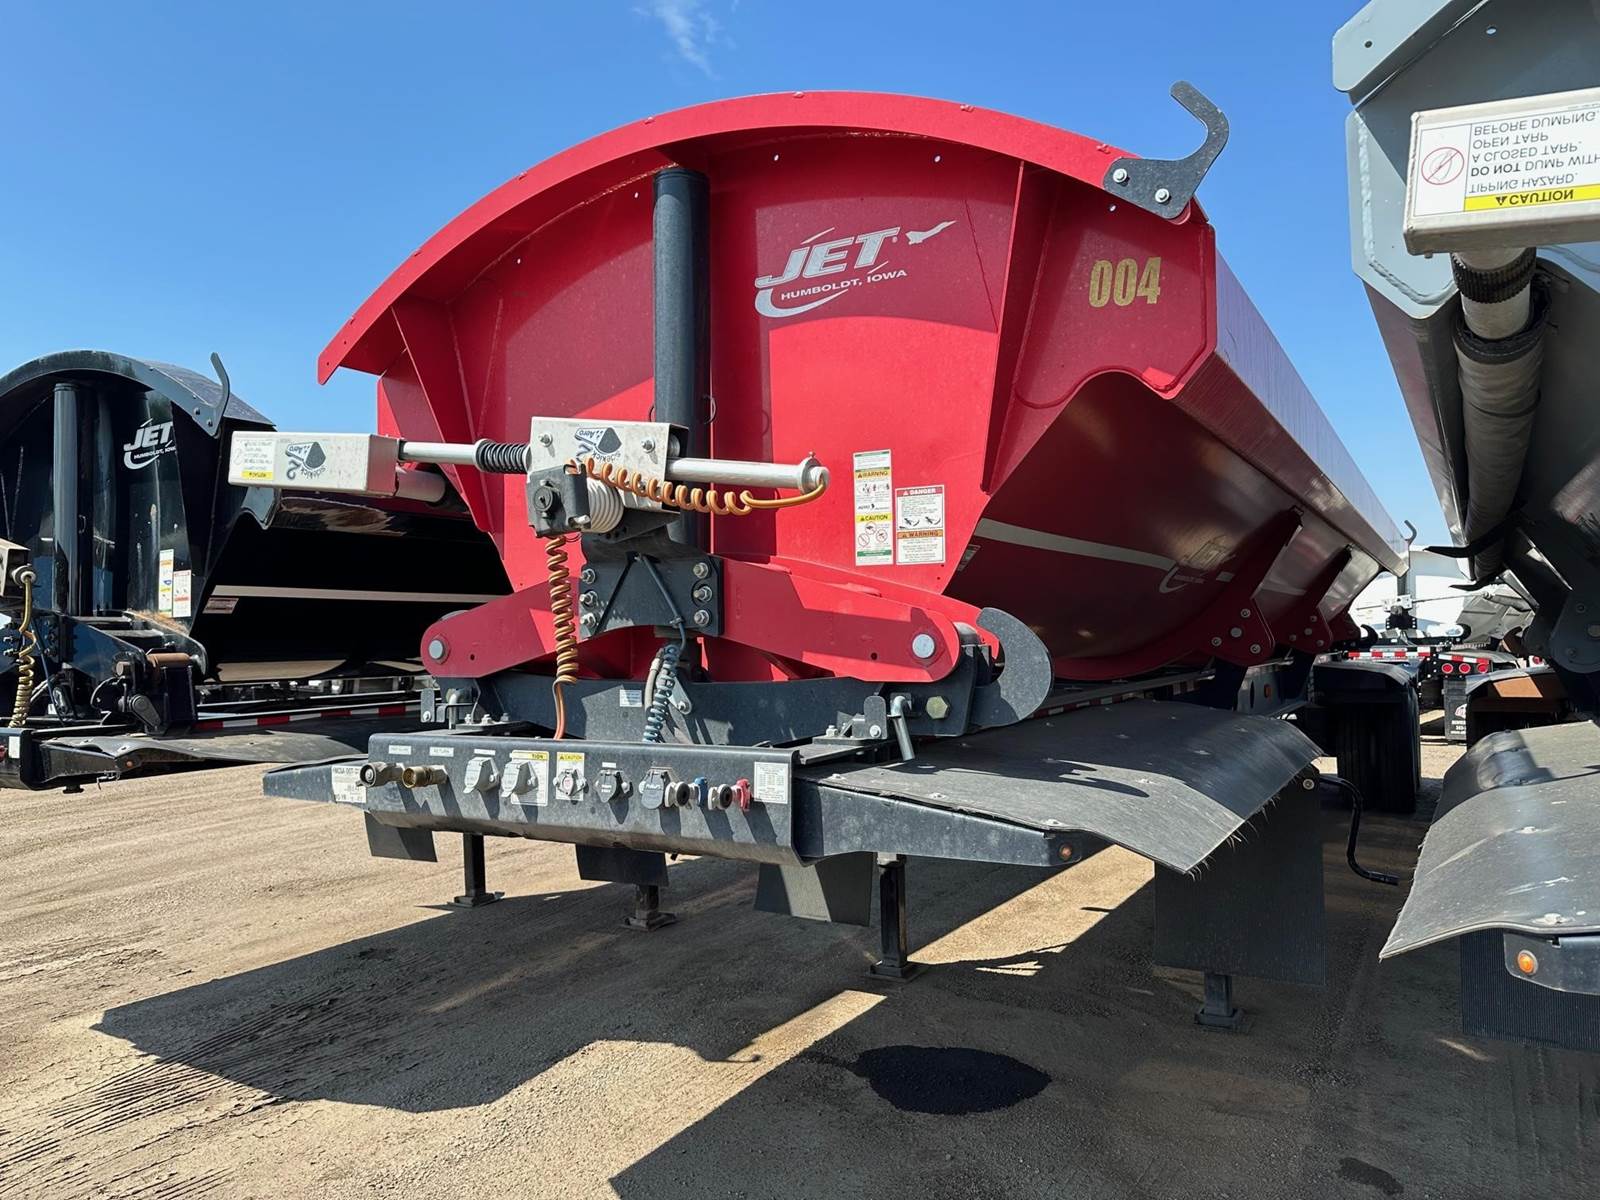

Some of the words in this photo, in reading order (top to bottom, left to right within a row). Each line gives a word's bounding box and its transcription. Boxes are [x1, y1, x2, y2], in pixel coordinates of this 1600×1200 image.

[755, 227, 901, 288] JET
[781, 278, 862, 301] HUMBOLDT,
[867, 269, 908, 284] IOWA
[1088, 256, 1161, 308] 004
[123, 421, 174, 452] JET
[909, 530, 939, 538] WARNING
